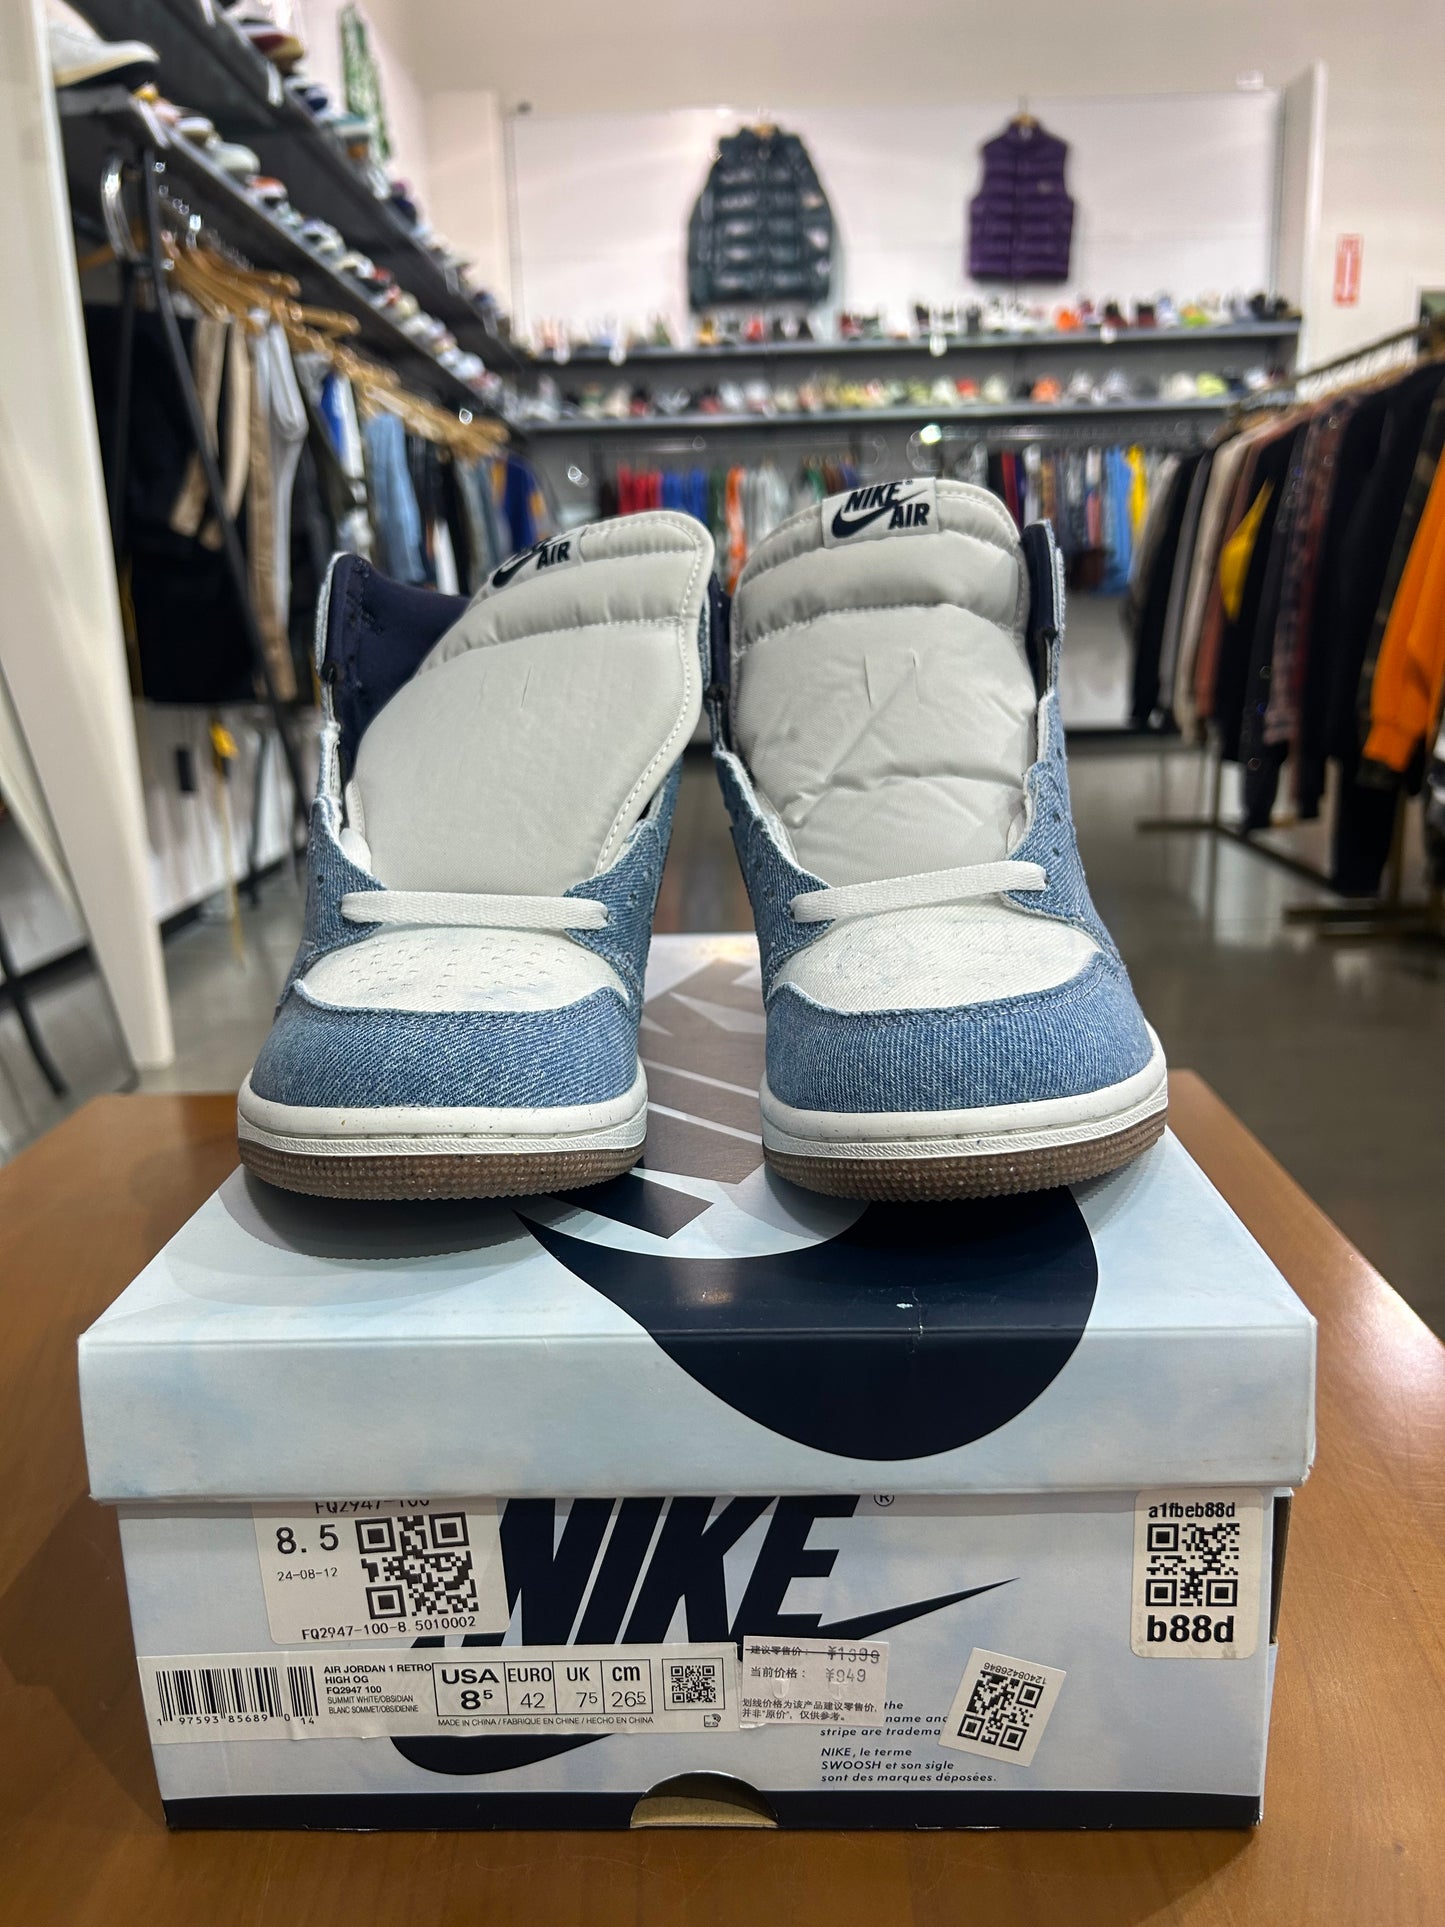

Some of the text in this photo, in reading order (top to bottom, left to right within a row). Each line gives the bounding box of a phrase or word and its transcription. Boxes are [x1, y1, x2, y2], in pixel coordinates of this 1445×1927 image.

[843, 482, 904, 513] NIKE
[888, 503, 930, 530] AIR
[536, 541, 571, 570] AIR
[1148, 1502, 1235, 1518] a1fbeb88d
[277, 1567, 338, 1582] 24-08-12
[411, 1495, 861, 1656] NIKE
[1146, 1614, 1234, 1643] b88d
[324, 1666, 341, 1674] AIR
[344, 1665, 386, 1673] JORDAN
[397, 1664, 432, 1672] RETRO
[441, 1668, 500, 1684] USA
[508, 1666, 552, 1682] EURO
[566, 1666, 590, 1682] UK
[826, 1668, 866, 1682] ¥949
[984, 1662, 1046, 1685] 12408426846
[325, 1676, 350, 1684] HIGH
[326, 1686, 382, 1694] FQ2947 100
[328, 1695, 414, 1704] SUMMIT WHITE/OBSIDIAN
[520, 1692, 546, 1708] 42
[884, 1701, 903, 1710] the
[328, 1705, 418, 1714] BLANC SOMMET/OBSIDIENNE
[157, 1714, 314, 1726] 1 97593 85689 0 14
[586, 1716, 614, 1724] HECHO
[616, 1716, 626, 1724] EN
[628, 1716, 654, 1724] CHINA
[820, 1727, 941, 1738] stripe are tradema
[821, 1748, 912, 1758] NIKE, le terme
[821, 1760, 954, 1771] SWOOSH et son sigle
[821, 1772, 996, 1784] sont des marques déposées.
